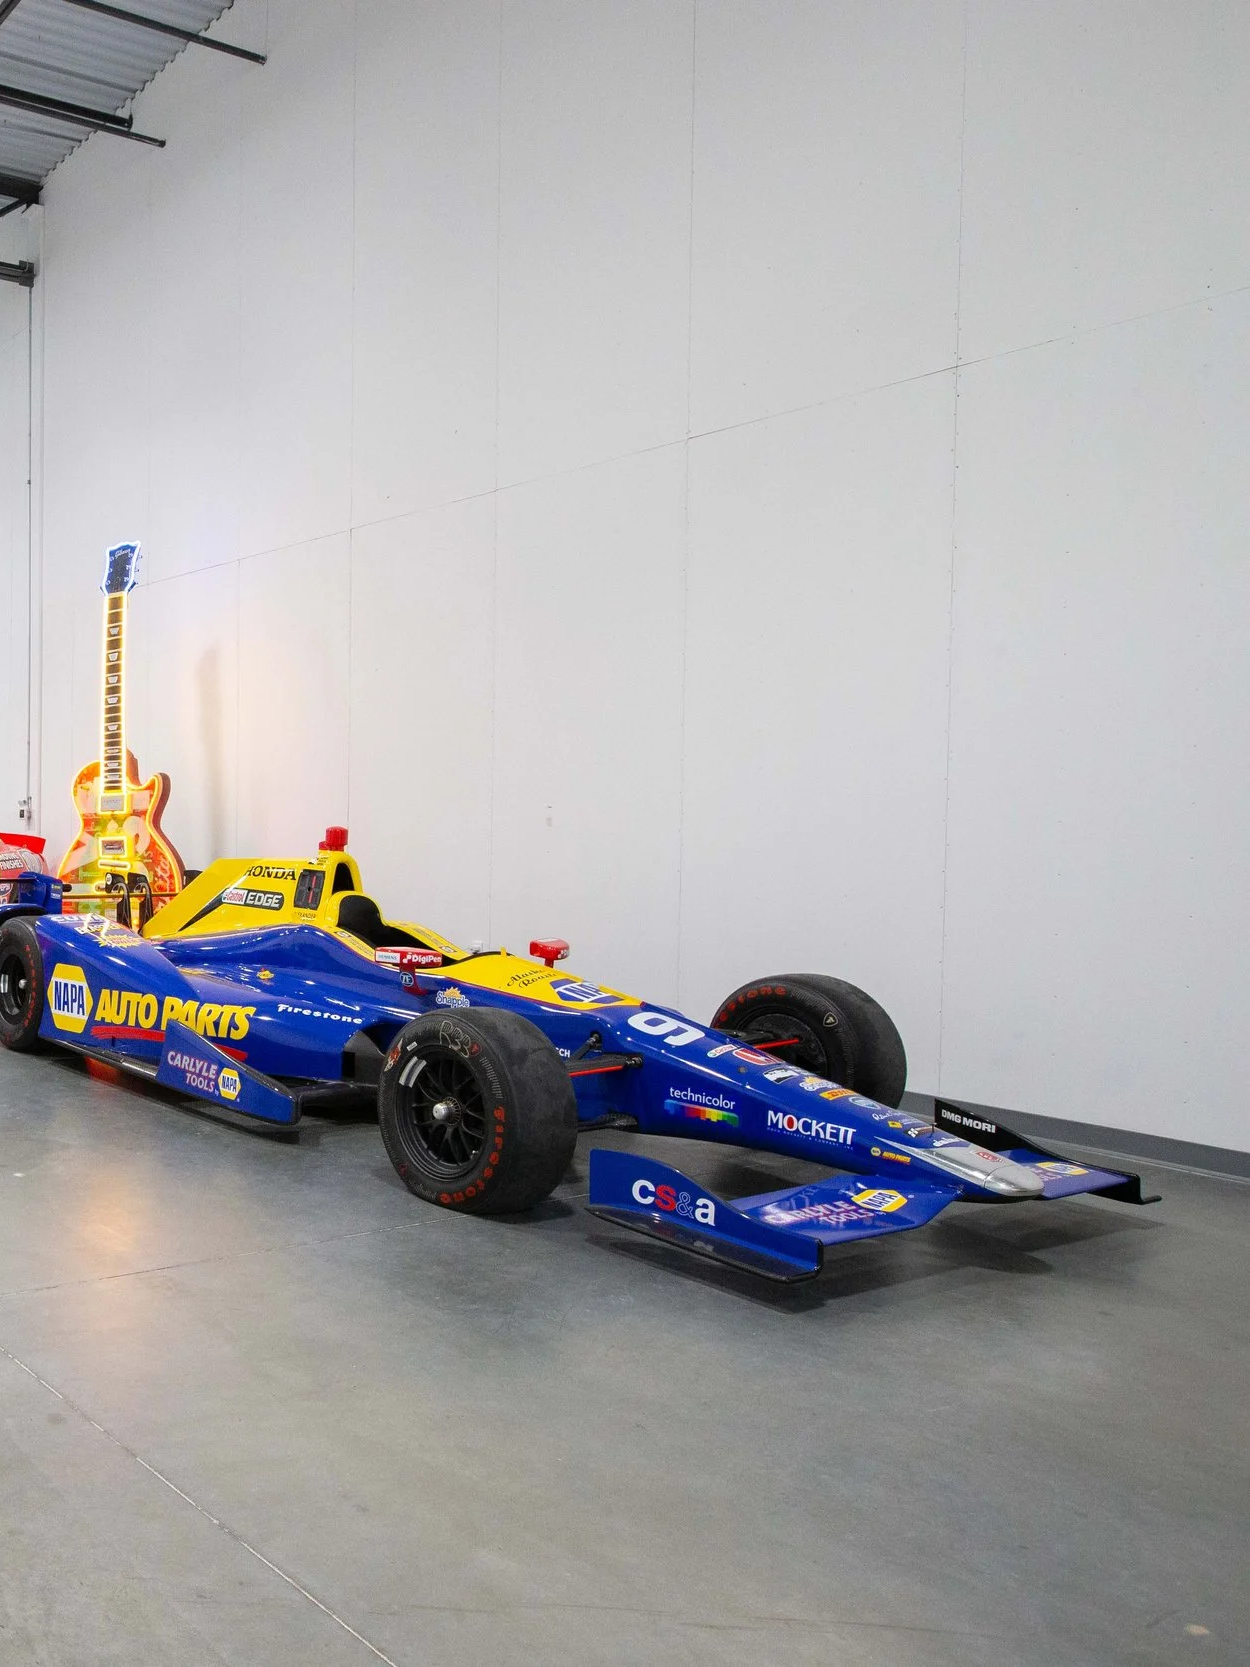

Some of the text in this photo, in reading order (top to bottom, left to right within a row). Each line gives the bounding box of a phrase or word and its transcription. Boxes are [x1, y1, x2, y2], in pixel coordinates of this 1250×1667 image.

[245, 865, 297, 881] HONDA
[245, 891, 283, 908] EDGE
[411, 953, 442, 964] DigiPen
[53, 980, 86, 1017] NAPA
[435, 990, 470, 1008] Snapple
[94, 988, 257, 1041] AUTO PARTS
[277, 1003, 363, 1025] Firestone
[167, 1051, 218, 1079] CARLYLE
[185, 1073, 215, 1092] TOOLS
[221, 1075, 237, 1093] NAPA
[669, 1086, 736, 1110] technicolor
[766, 1109, 857, 1145] MOCKETT
[941, 1108, 996, 1134] DMG MORI
[631, 1179, 716, 1227] cs&a
[860, 1191, 899, 1209] NAPA
[764, 1200, 857, 1224] CARLYLE
[818, 1209, 875, 1225] TOOLS
